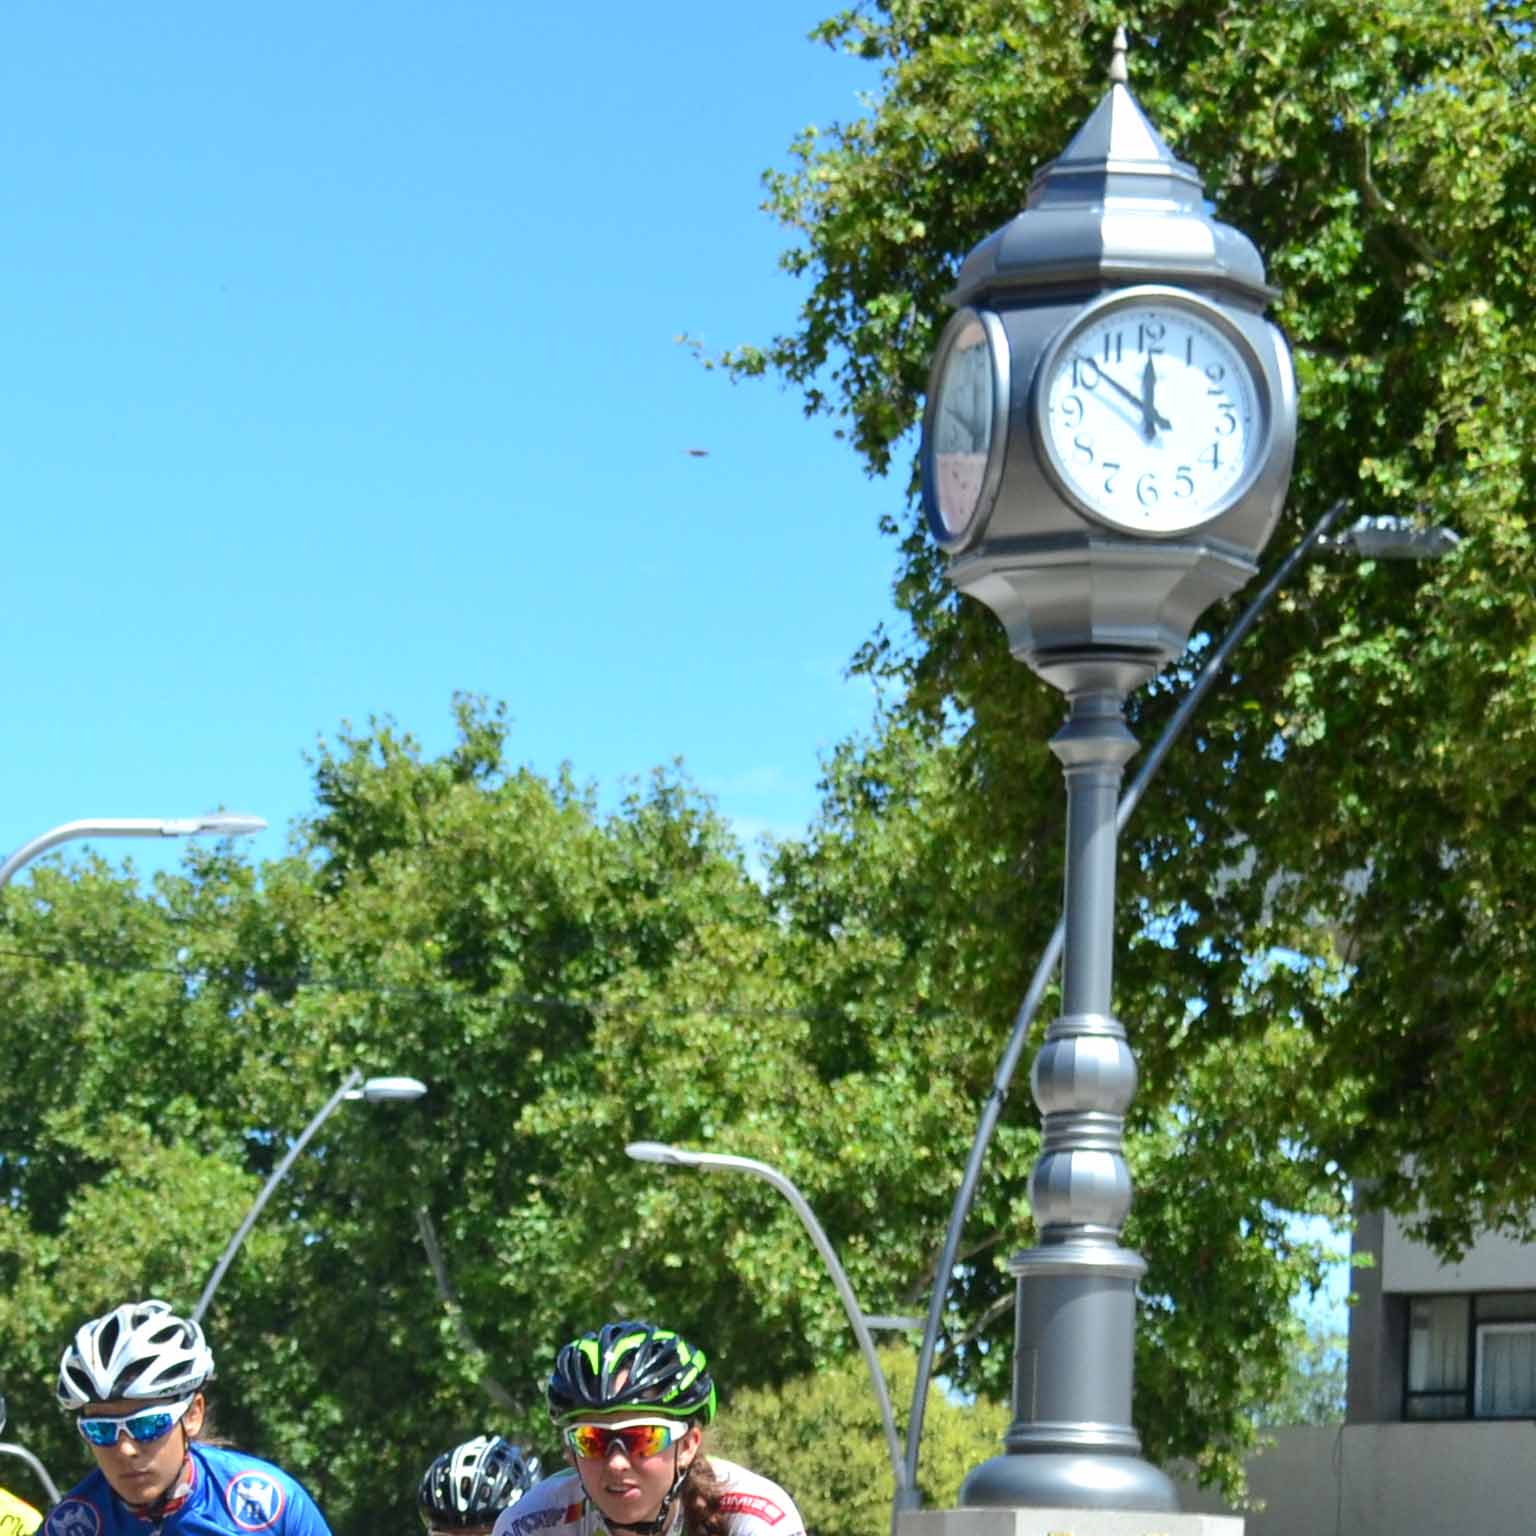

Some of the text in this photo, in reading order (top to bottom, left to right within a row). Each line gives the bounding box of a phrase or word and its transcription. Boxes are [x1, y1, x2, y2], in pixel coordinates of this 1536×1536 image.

[1104, 332, 1123, 363] 11
[1138, 321, 1166, 354] 12
[1205, 363, 1226, 395] 2
[1061, 394, 1084, 427] 9
[1215, 402, 1237, 436] 3
[1073, 432, 1094, 463] 8
[1197, 442, 1225, 471] 4
[1102, 462, 1121, 494] 7
[1136, 473, 1159, 506] 6
[1173, 465, 1195, 497] 5
